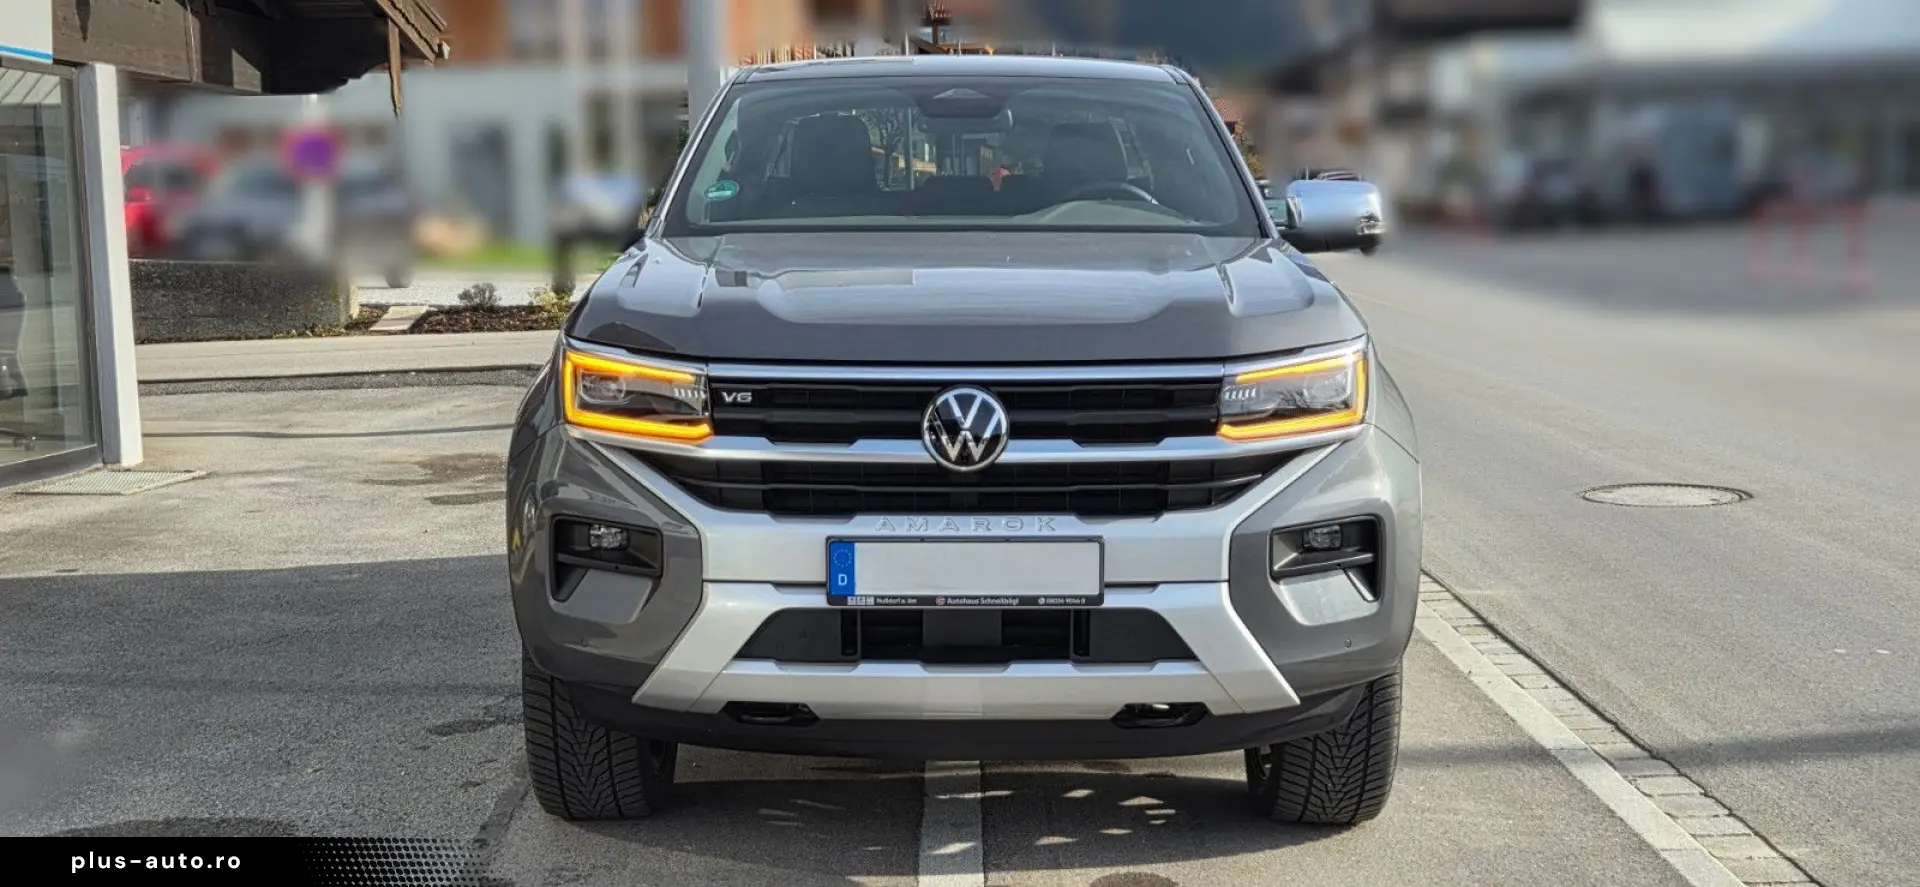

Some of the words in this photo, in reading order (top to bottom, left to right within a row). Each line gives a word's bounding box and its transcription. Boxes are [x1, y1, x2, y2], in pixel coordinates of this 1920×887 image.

[721, 391, 752, 403] V6
[926, 388, 1005, 466] VW
[876, 516, 1056, 532] AMAROK
[838, 573, 848, 586] D
[947, 597, 978, 605] Autohaus
